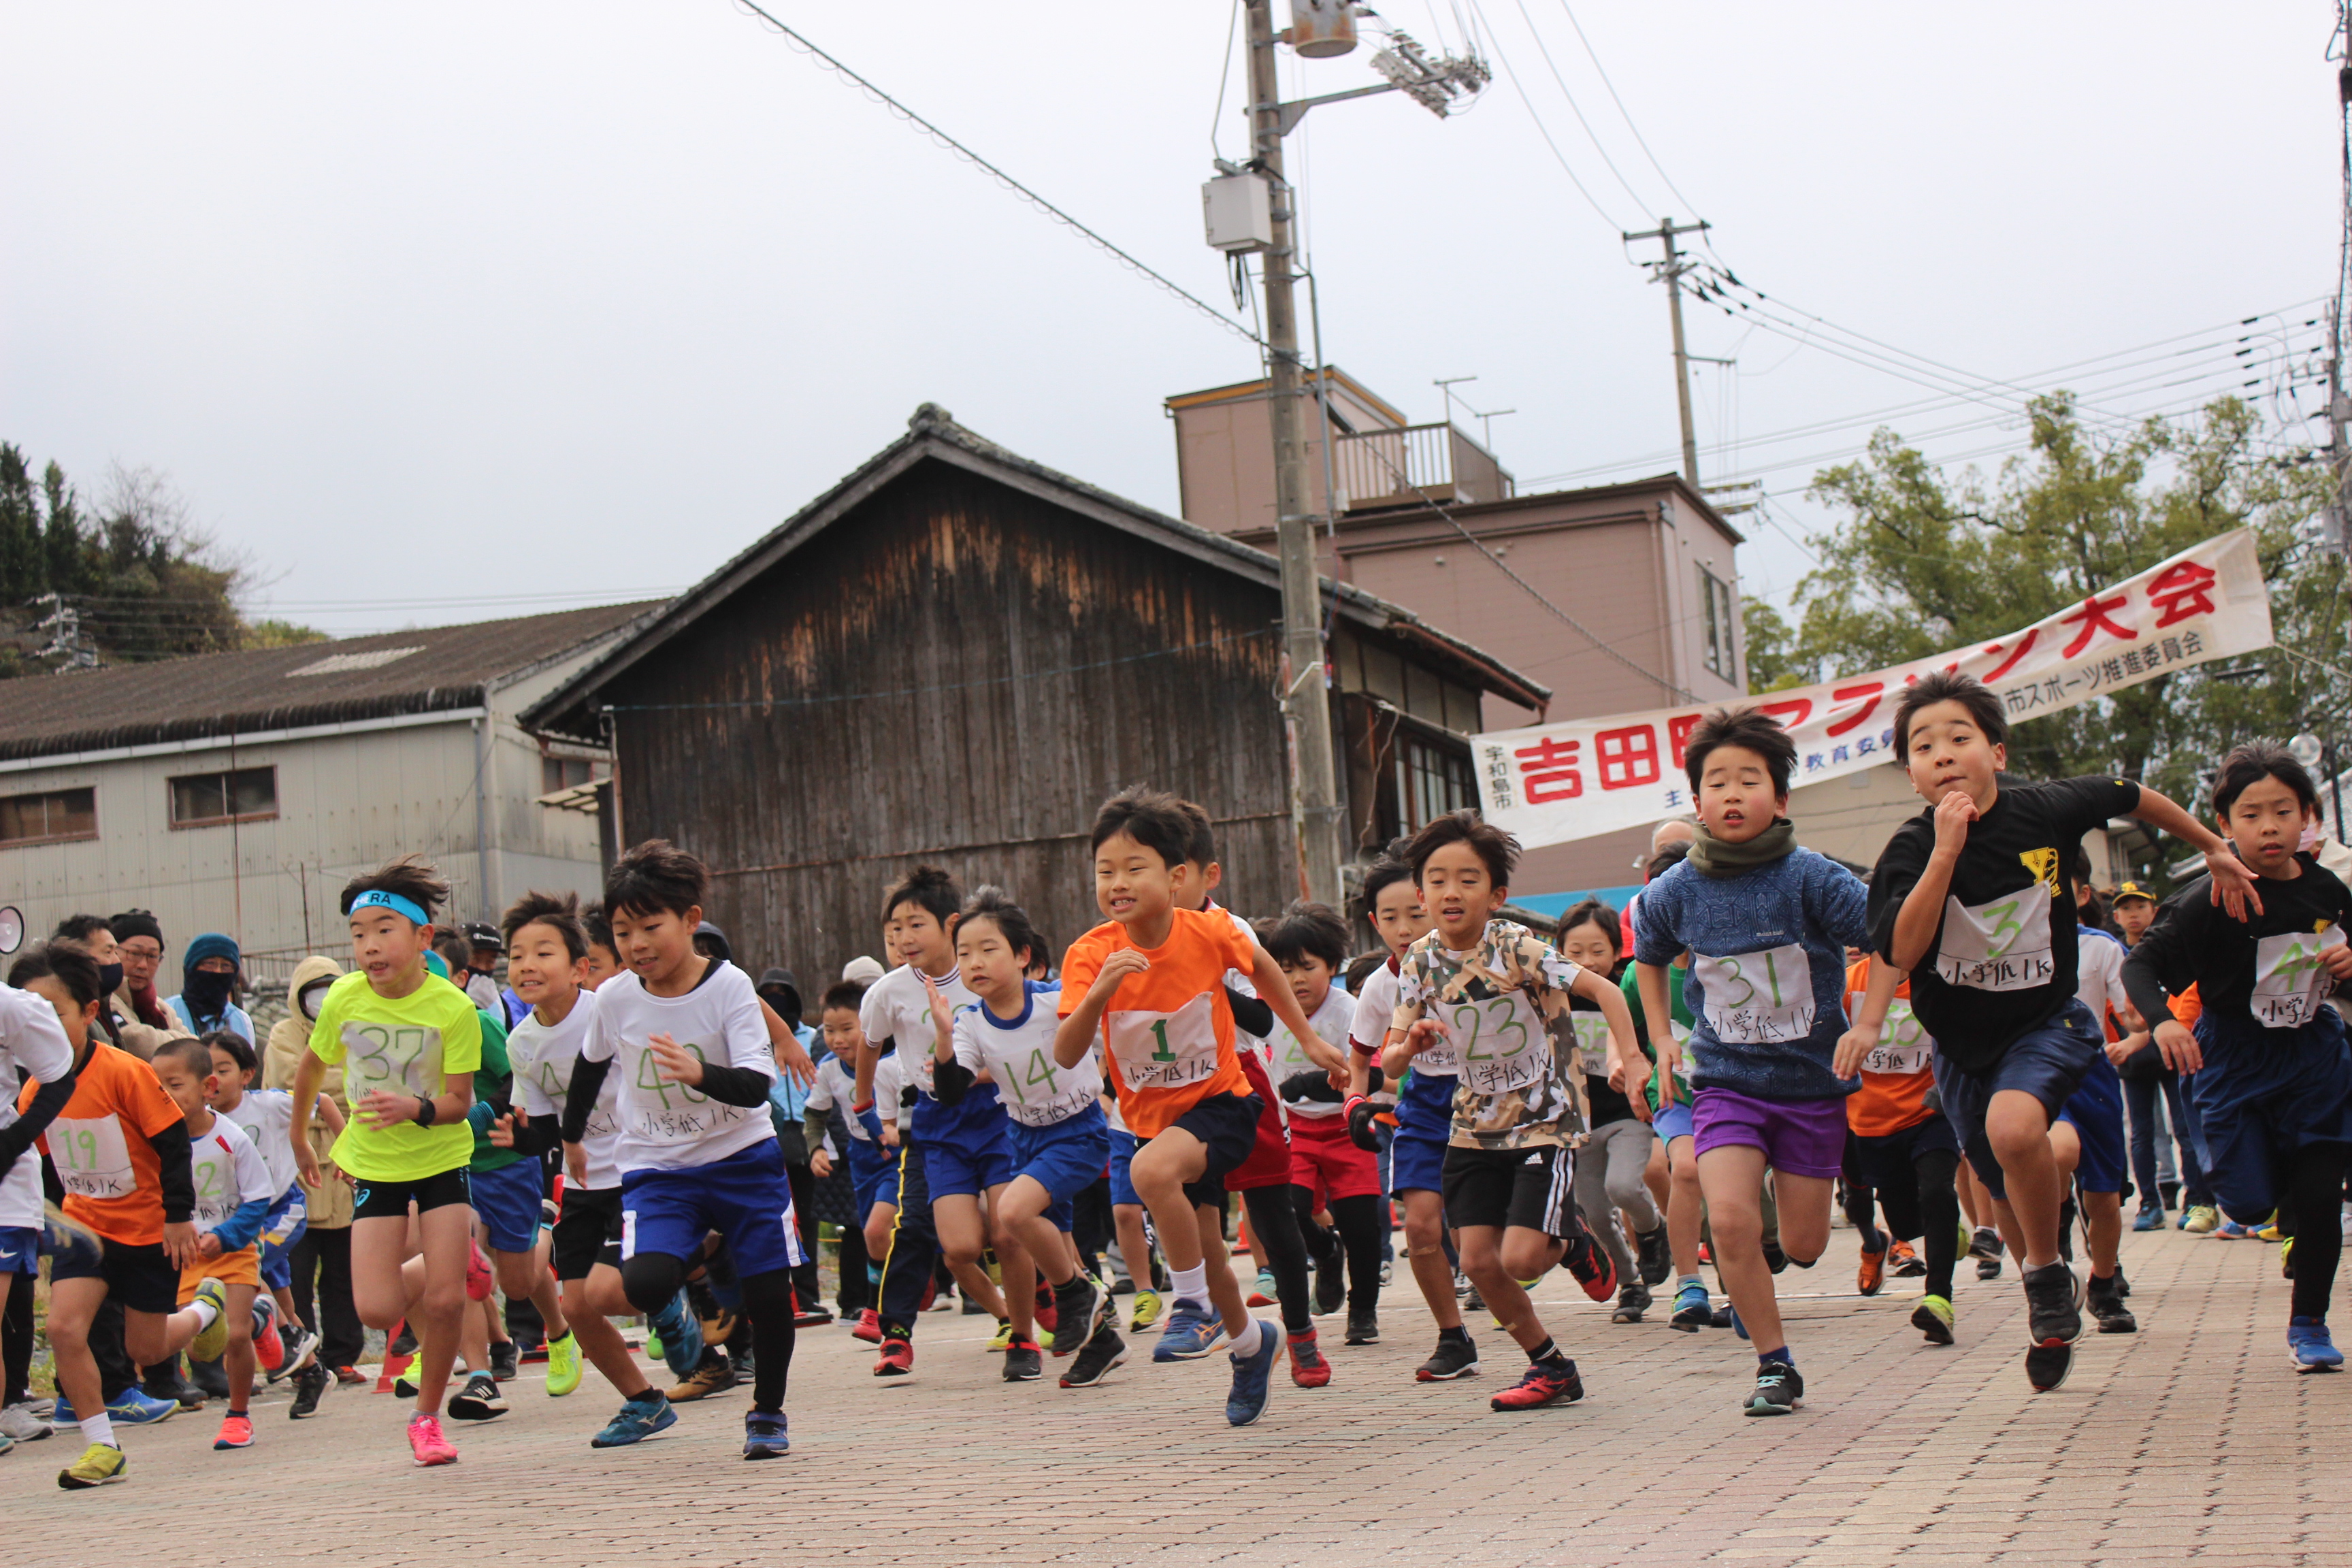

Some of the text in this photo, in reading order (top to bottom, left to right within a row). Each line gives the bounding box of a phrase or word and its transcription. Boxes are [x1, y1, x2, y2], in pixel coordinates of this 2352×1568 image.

[1515, 561, 2215, 804] 吉田マラン大会
[2005, 631, 2204, 715] 市スポーツ推進委員会
[1665, 790, 1684, 808] 主
[1983, 900, 2021, 958] 3
[1716, 952, 1782, 1009] 31
[359, 1027, 424, 1085] 37
[1149, 1019, 1177, 1062] 1
[1454, 998, 1527, 1060] 23
[1572, 1019, 1610, 1054] 35
[1004, 1048, 1058, 1105] 14
[59, 1130, 97, 1170] 19
